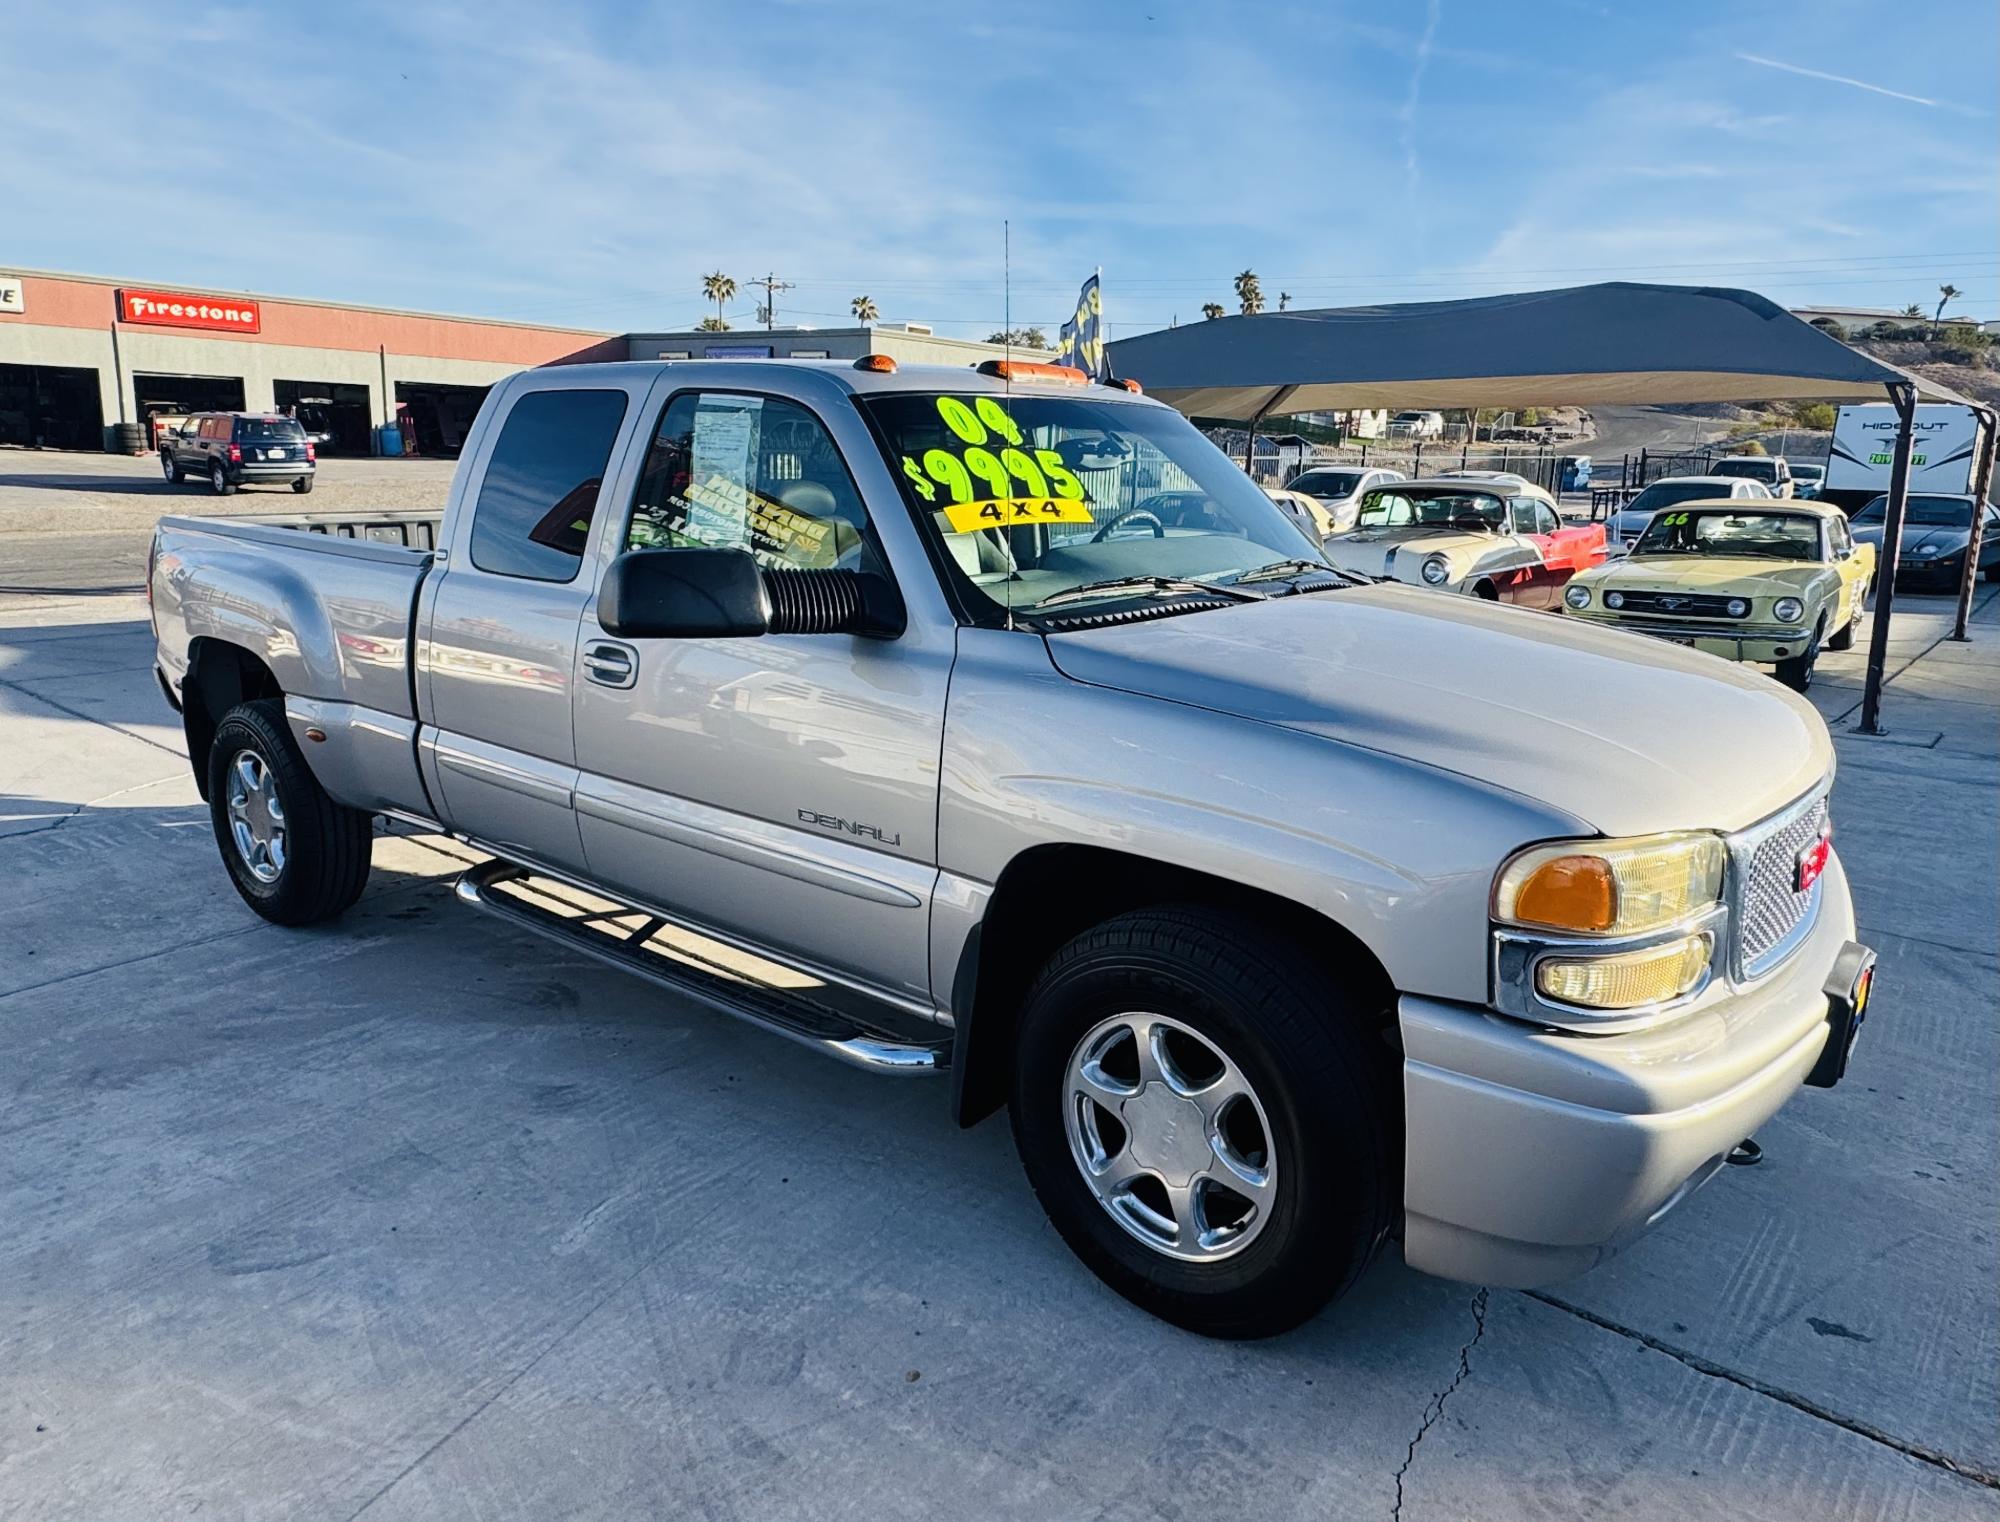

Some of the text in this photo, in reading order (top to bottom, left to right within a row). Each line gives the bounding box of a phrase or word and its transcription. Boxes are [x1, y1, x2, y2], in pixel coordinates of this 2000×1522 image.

[129, 297, 254, 323] Firestone
[936, 396, 1024, 446] 04
[902, 447, 1085, 503] $9995
[1662, 512, 1690, 526] 66
[798, 808, 901, 846] DENALI
